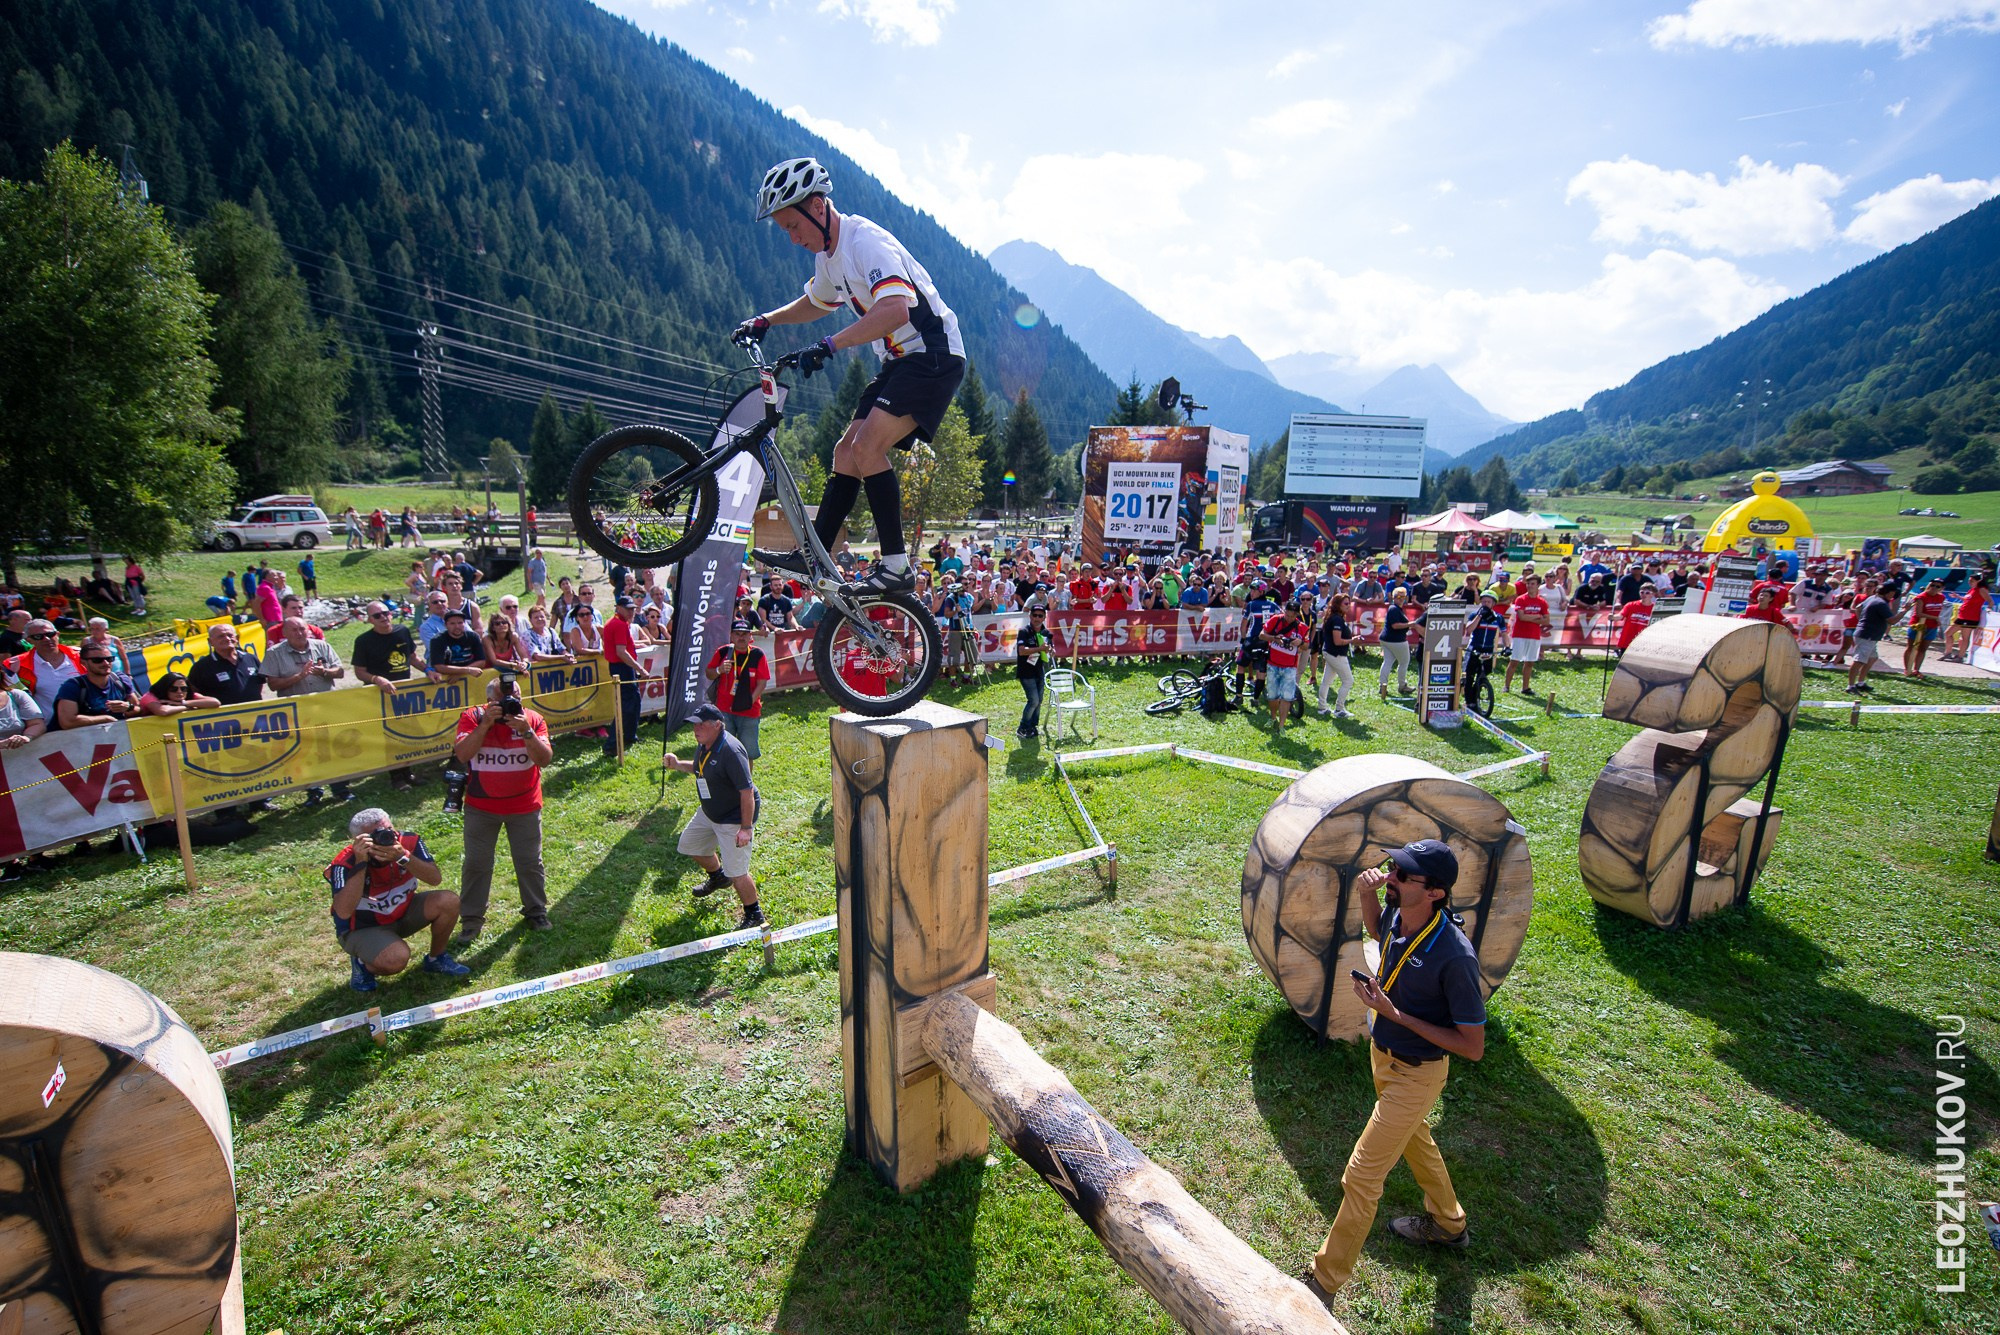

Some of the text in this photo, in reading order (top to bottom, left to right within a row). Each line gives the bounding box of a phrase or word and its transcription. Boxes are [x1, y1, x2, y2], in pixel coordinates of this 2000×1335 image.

[718, 451, 752, 508] 4
[1110, 493, 1173, 520] 2017
[1152, 524, 1171, 534] AUG.
[1337, 518, 1368, 526] Red Bull
[684, 559, 718, 703] #TrialsWorlds
[1058, 617, 1167, 648] Val di Sole
[1188, 614, 1239, 644] Val di
[1428, 620, 1462, 631] START
[1434, 634, 1452, 658] 4
[537, 666, 592, 694] WD-40
[391, 684, 461, 718] WD-40
[192, 711, 290, 754] WD-40
[549, 716, 593, 729] ww.wd40.it
[477, 753, 528, 765] PHOTO
[202, 776, 294, 802] www.wd40.it
